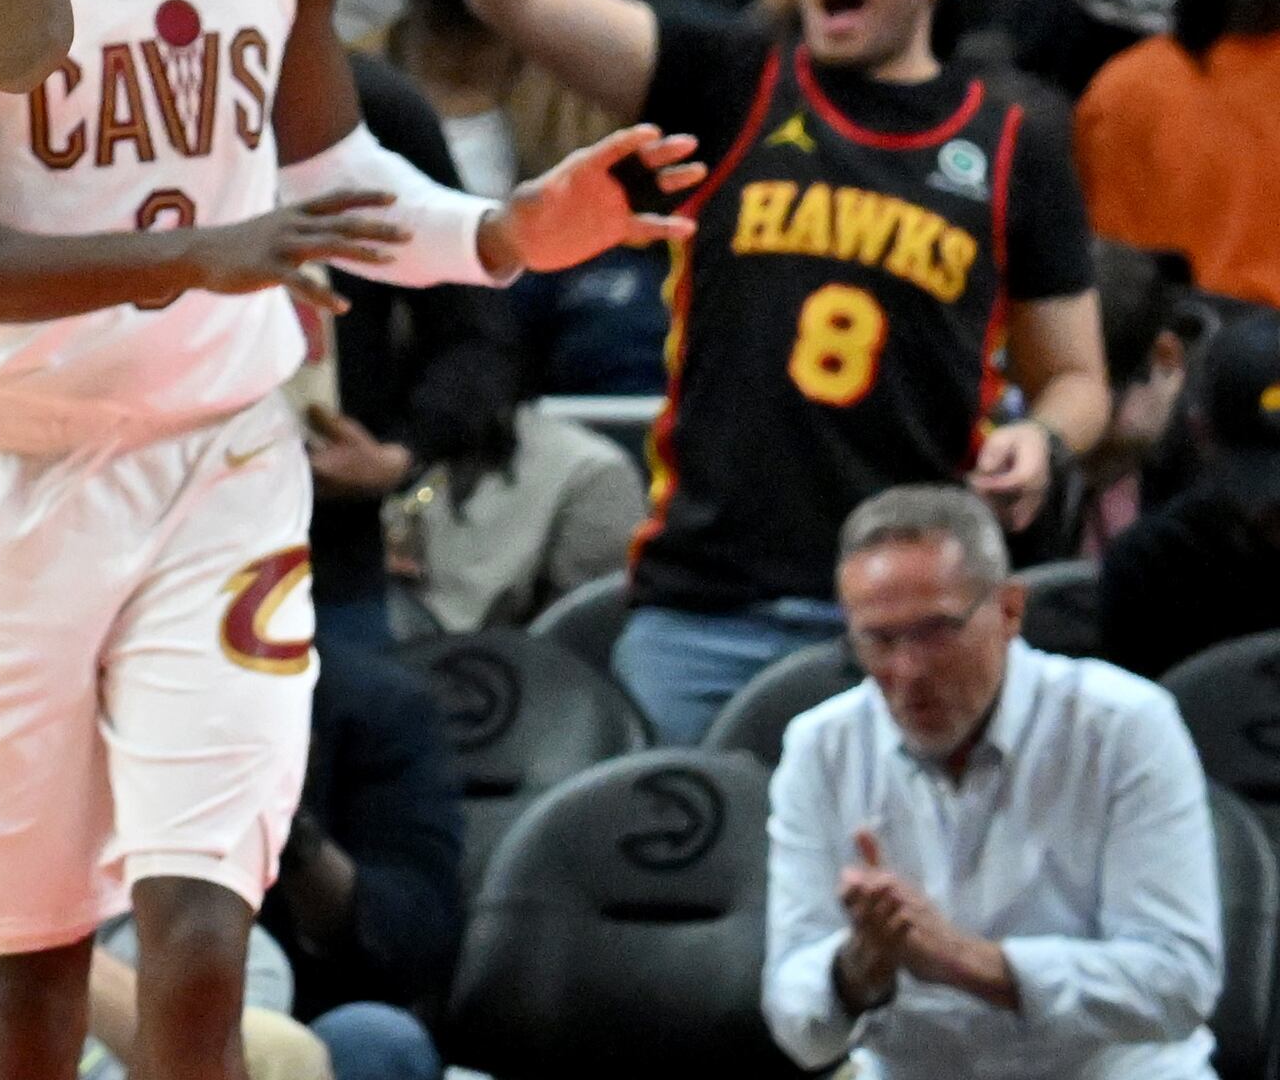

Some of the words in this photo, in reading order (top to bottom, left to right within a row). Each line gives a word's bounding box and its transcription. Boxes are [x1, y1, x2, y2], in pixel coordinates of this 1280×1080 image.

[29, 27, 268, 170] CAVS
[730, 178, 978, 305] HAWKS
[788, 281, 889, 408] 8
